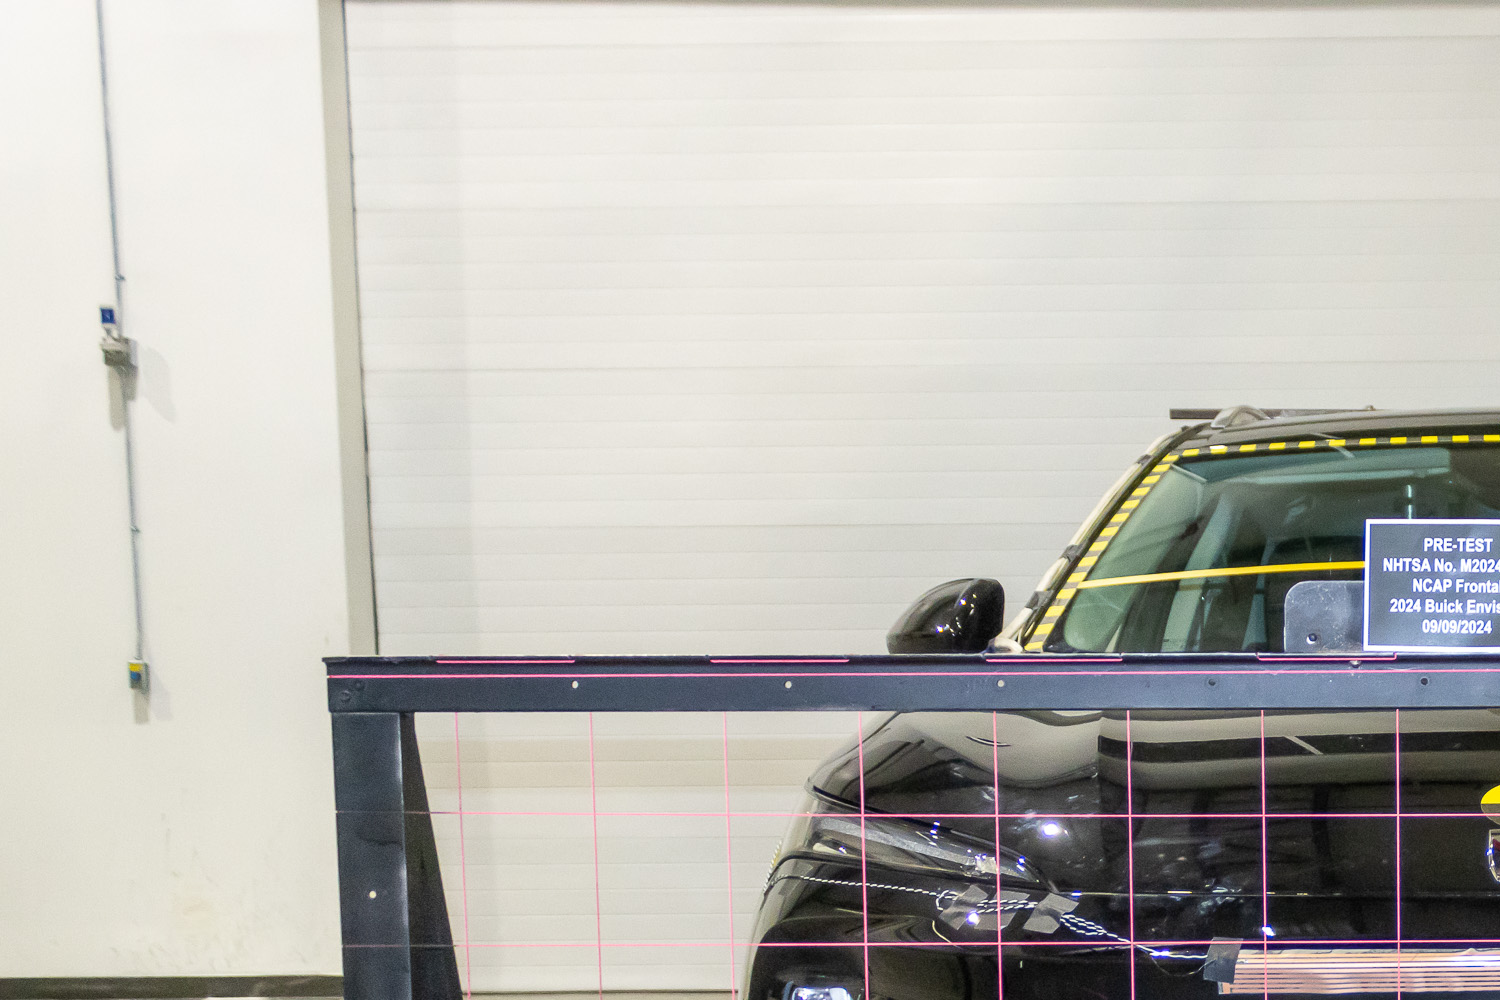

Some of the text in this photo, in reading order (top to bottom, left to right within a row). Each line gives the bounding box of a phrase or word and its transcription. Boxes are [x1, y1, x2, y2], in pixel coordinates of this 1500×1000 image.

[1424, 538, 1493, 552] PRE-TEST
[1383, 558, 1431, 572] NHTSA
[1435, 559, 1456, 573] No.
[1413, 578, 1452, 592] NCAP
[1390, 599, 1421, 613] 2024
[1425, 599, 1463, 613] Buick
[1422, 619, 1492, 634] 09/09/2024
